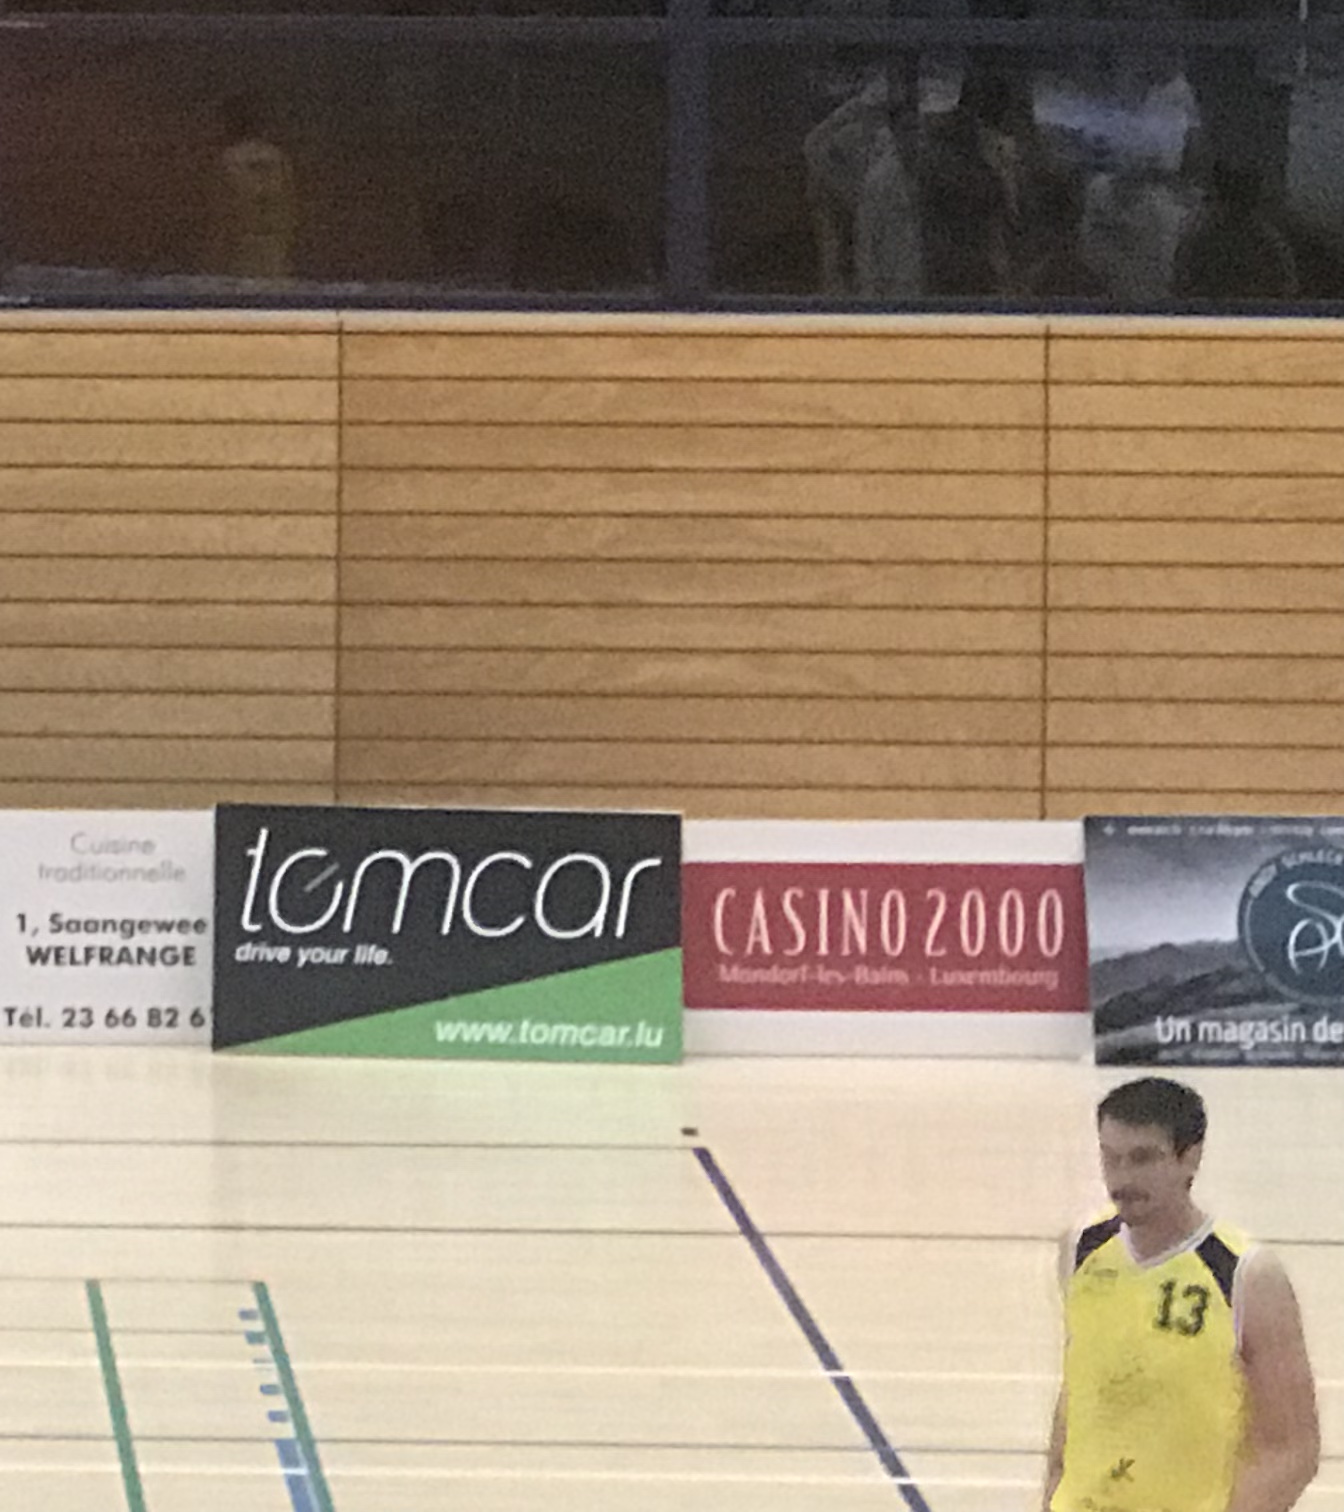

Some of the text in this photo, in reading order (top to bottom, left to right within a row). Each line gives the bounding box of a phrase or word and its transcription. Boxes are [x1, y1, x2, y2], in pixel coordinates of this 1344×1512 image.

[70, 832, 156, 856] Cuisine
[38, 861, 187, 884] traditionnelle
[17, 913, 208, 940] 1, Saangewee
[713, 888, 1064, 957] CASINO 2000
[26, 946, 197, 968] WELFRANGE
[234, 942, 394, 968] drive your life.
[61, 1006, 95, 1029] 23
[105, 1006, 138, 1029] 66
[147, 1007, 179, 1029] 82
[434, 1019, 665, 1049] www.tomcar.lu
[1155, 1016, 1192, 1044] Un
[1198, 1016, 1307, 1050] magasin
[1152, 1278, 1210, 1336] 13
